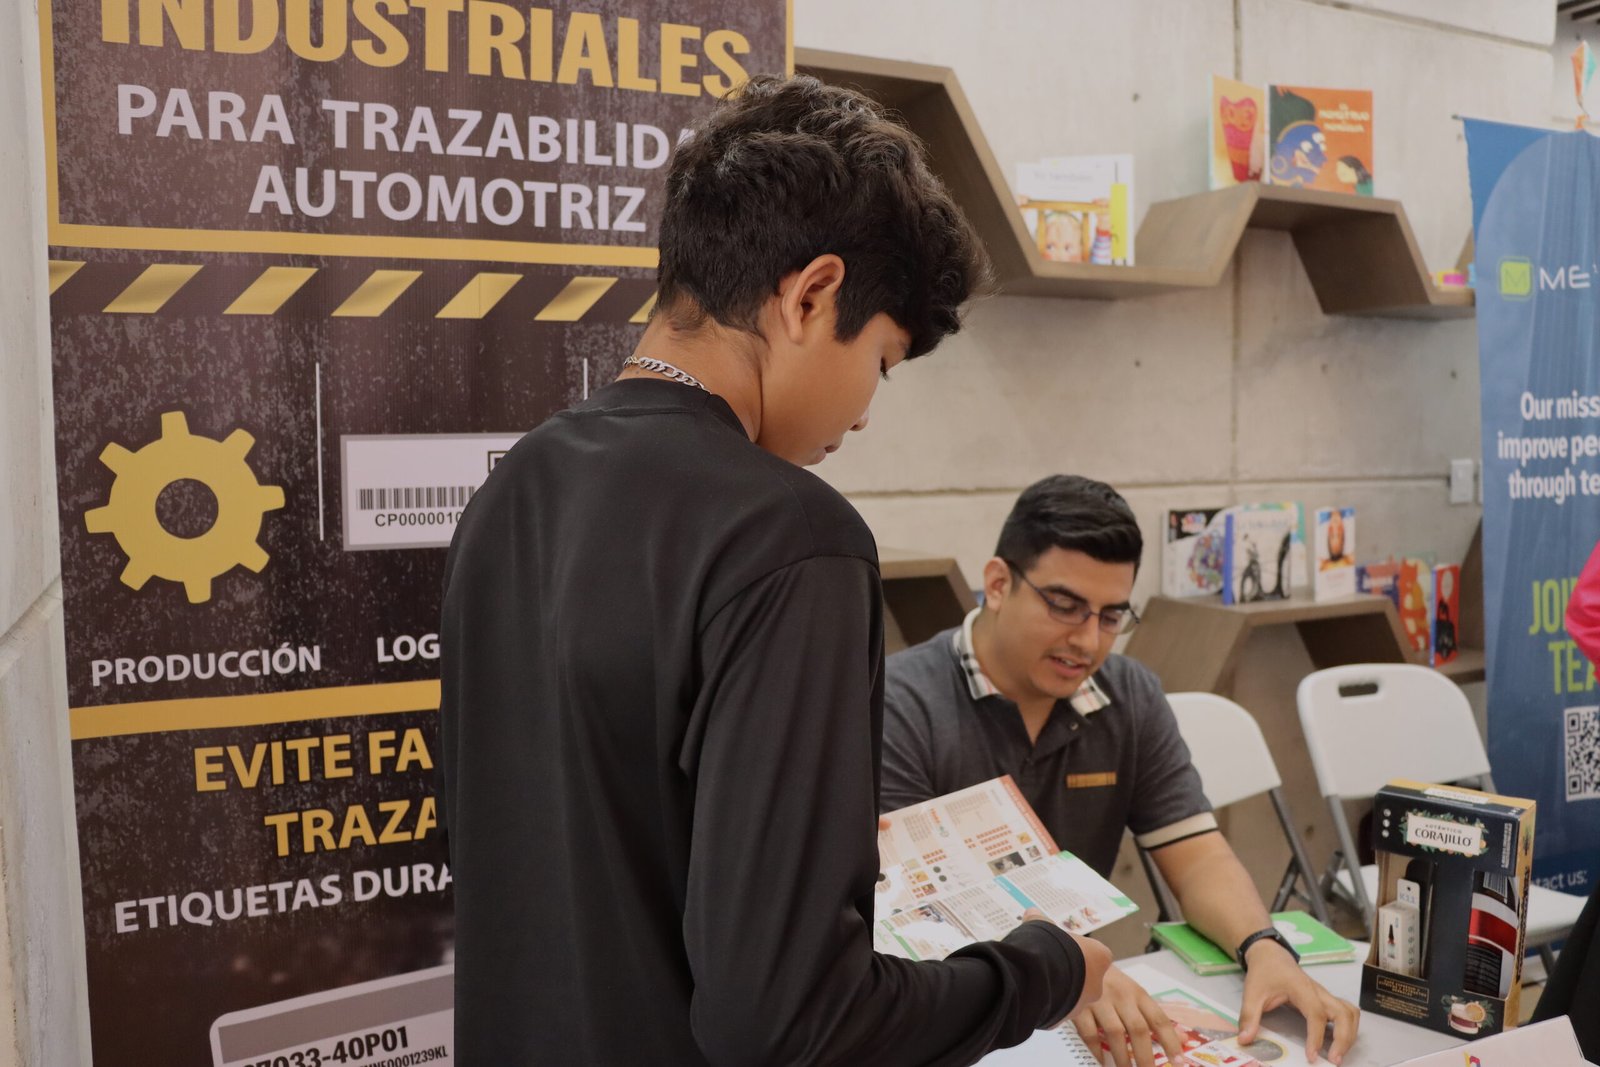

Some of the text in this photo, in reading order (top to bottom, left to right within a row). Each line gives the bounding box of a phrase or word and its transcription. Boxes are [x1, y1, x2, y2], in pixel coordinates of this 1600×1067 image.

[100, 0, 750, 100] INDUSTRIALES
[117, 84, 695, 170] PARA TRAZABILID
[248, 164, 647, 232] AUTOMOTRIZ
[1539, 264, 1599, 290] ME
[1520, 391, 1554, 420] Our
[1498, 430, 1600, 467] improve pe
[1508, 466, 1576, 505] through
[1528, 578, 1579, 635] JOI
[91, 633, 441, 687] PRODUCCIÓN LOG
[194, 728, 434, 791] EVITE FA
[264, 796, 437, 856] TRAZA
[1414, 827, 1471, 847] CORAJILLO
[114, 874, 343, 934] ETIQUETAS
